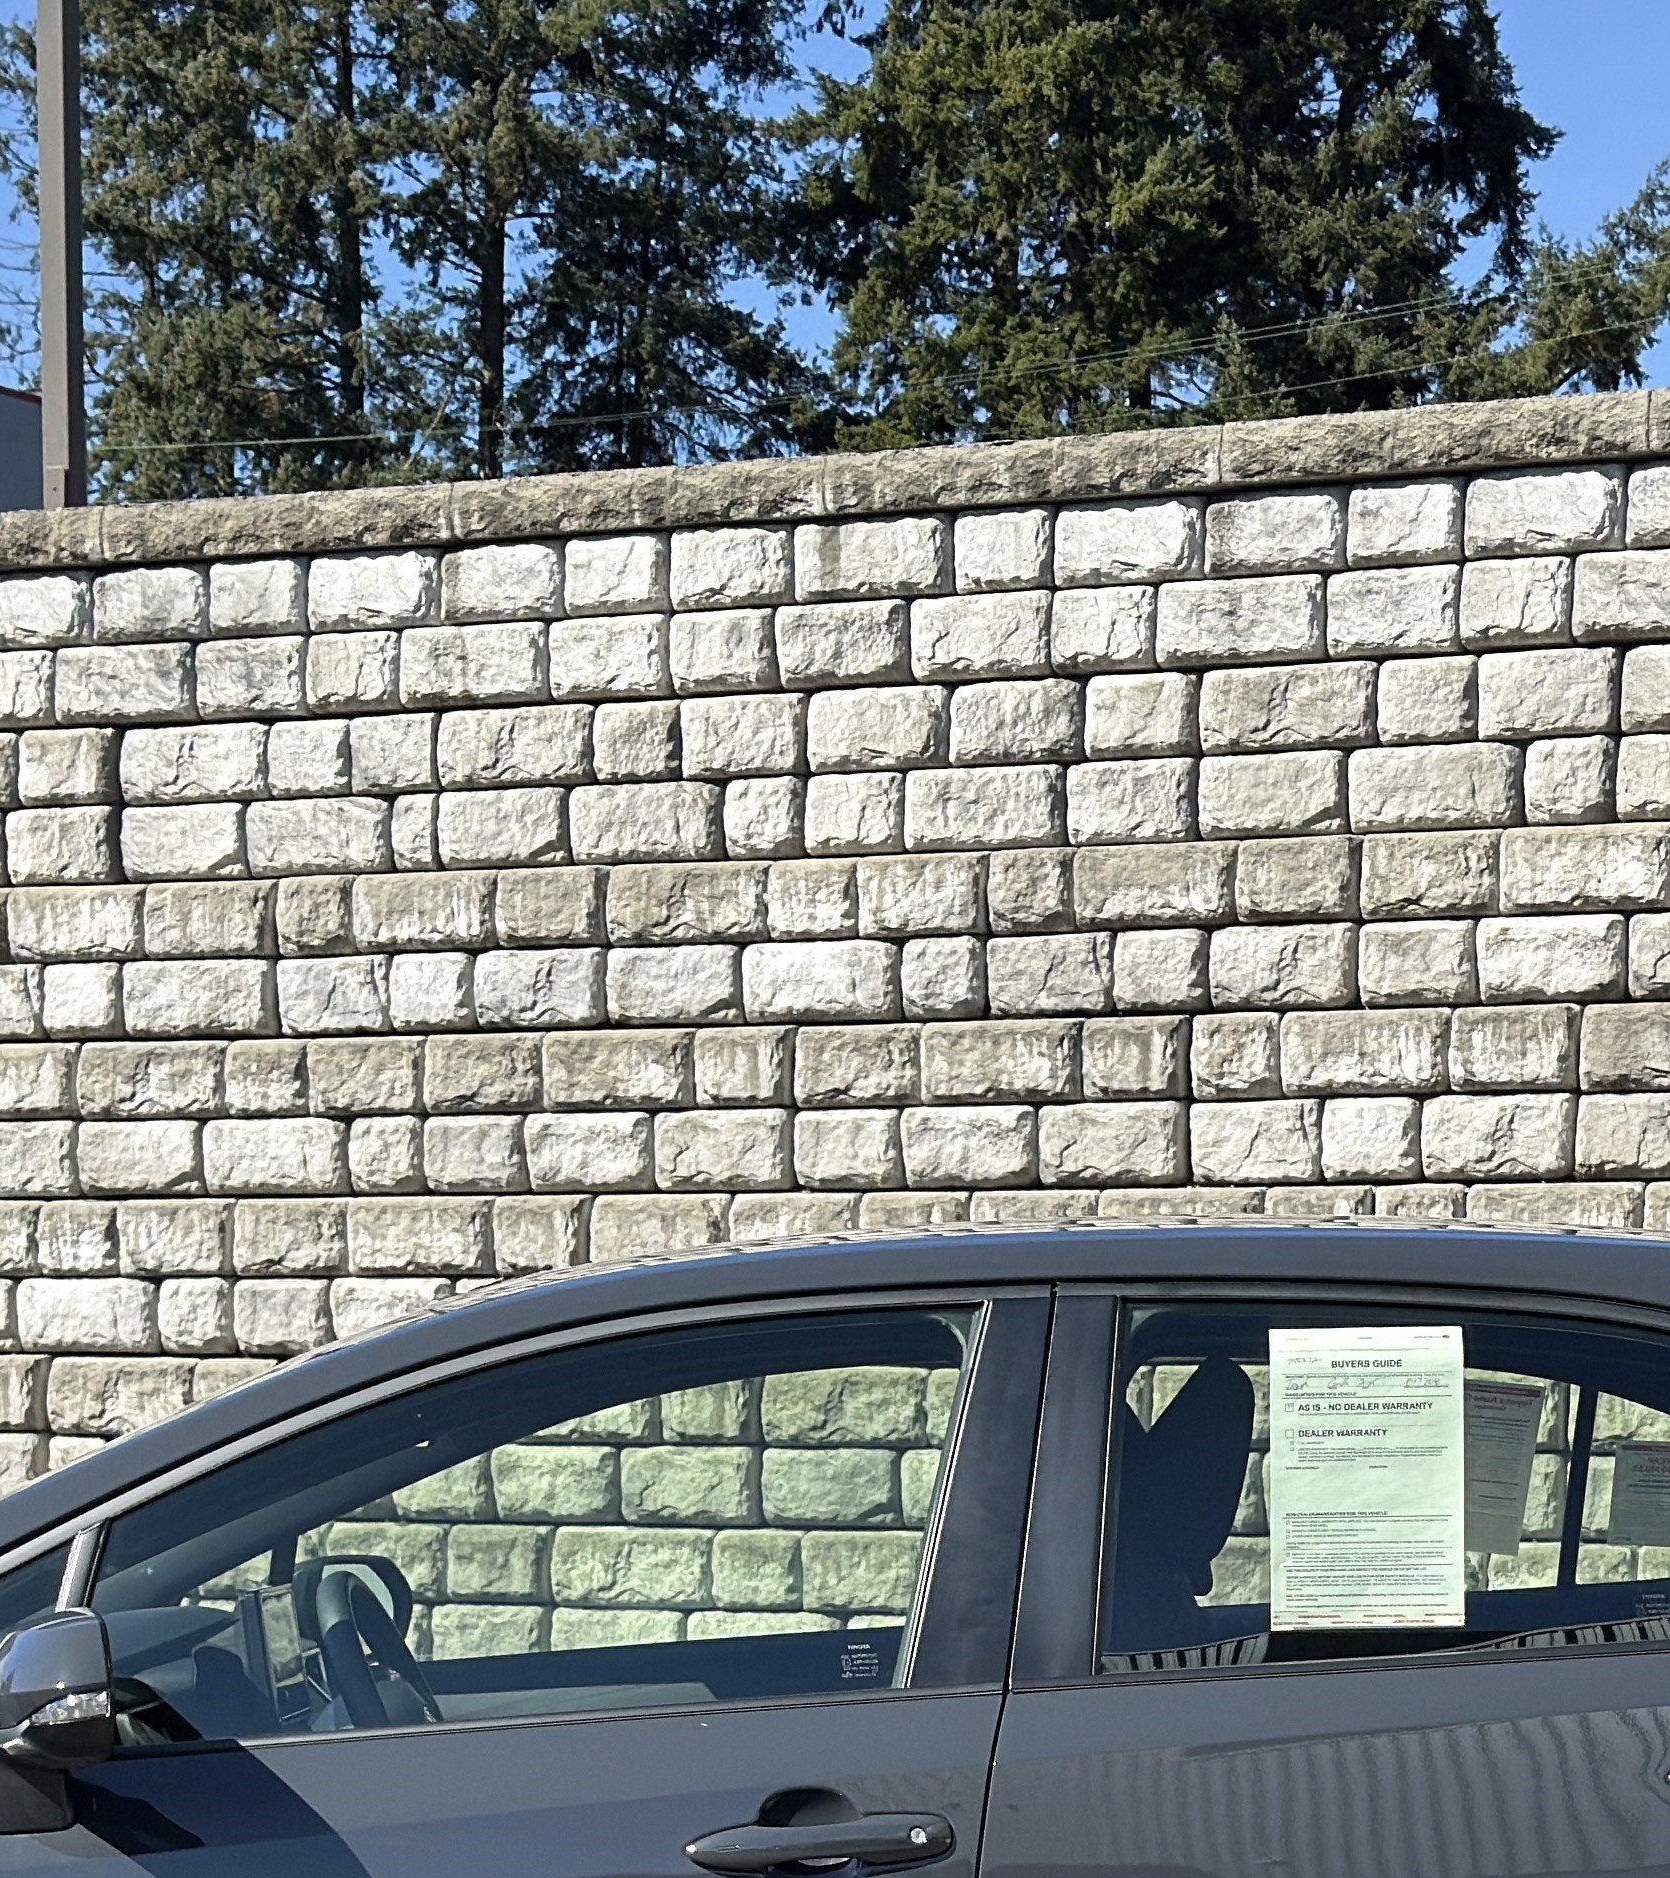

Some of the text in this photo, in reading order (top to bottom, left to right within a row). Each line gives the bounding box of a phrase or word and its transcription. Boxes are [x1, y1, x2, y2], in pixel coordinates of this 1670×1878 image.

[1331, 1360, 1370, 1369] BUYERS
[1372, 1359, 1403, 1368] GUIDE
[1312, 1403, 1321, 1411] IS
[1329, 1403, 1342, 1411] NO
[1344, 1402, 1380, 1411] DEALER
[1382, 1401, 1433, 1410] WARRANTY
[1298, 1429, 1388, 1438] DEALER WARRANTY
